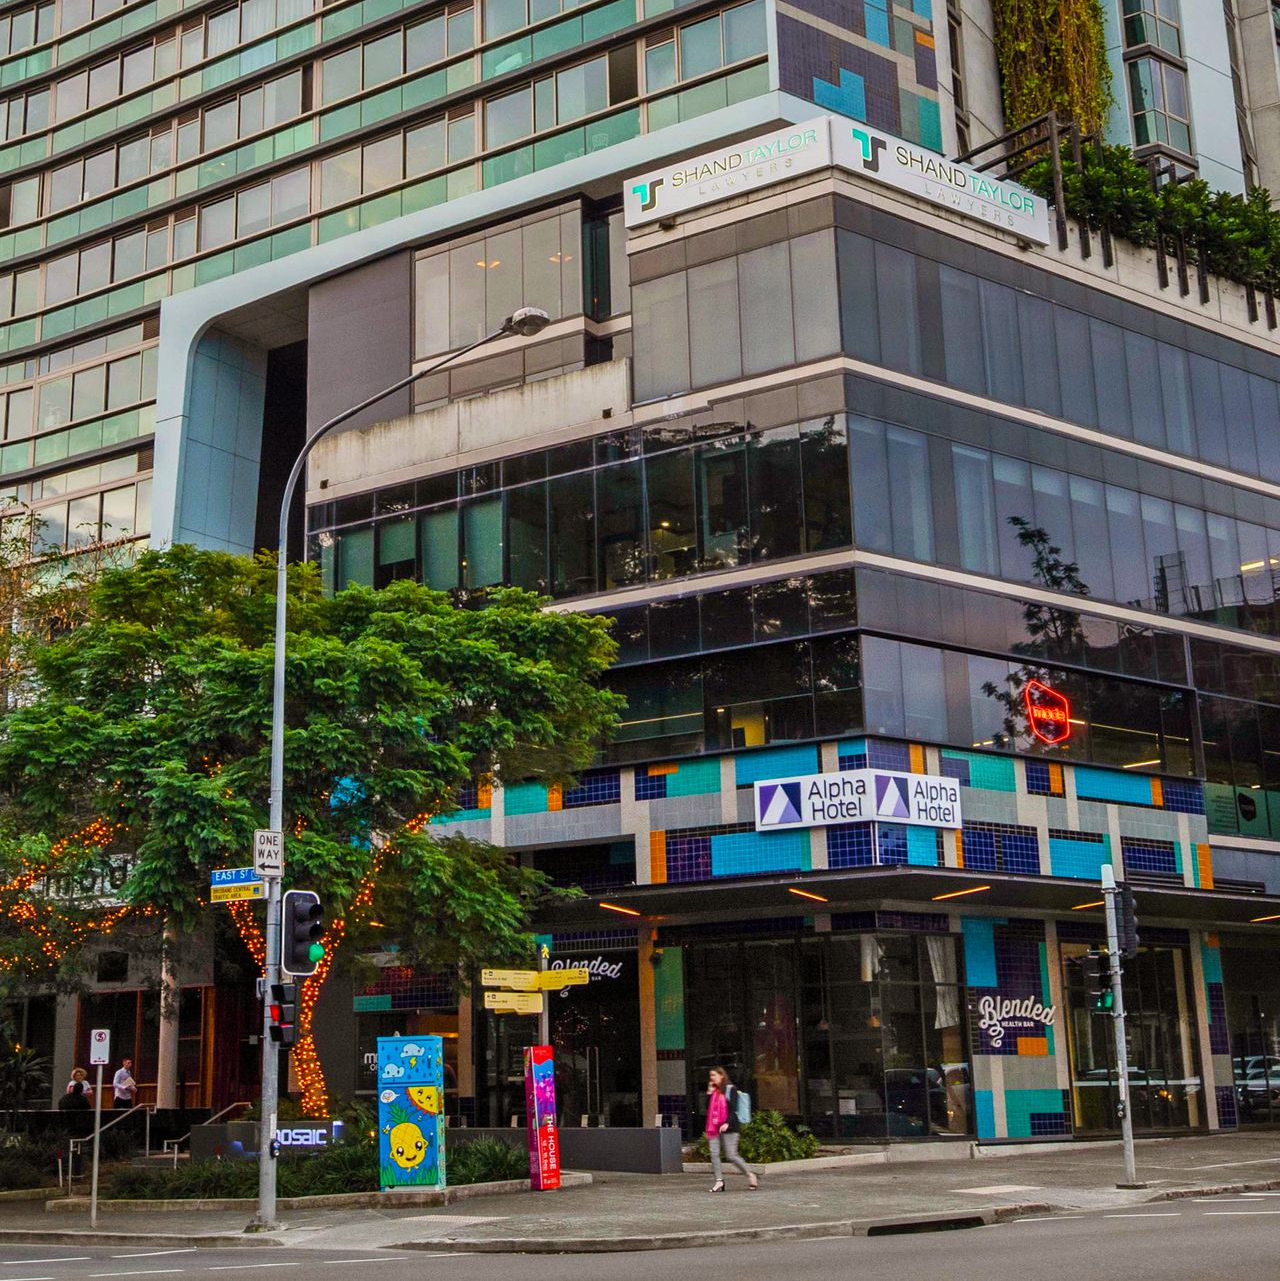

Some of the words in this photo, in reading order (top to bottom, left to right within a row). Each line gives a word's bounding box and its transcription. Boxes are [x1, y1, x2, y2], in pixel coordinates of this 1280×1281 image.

[671, 152, 743, 188] SHAND
[743, 128, 818, 165] TAYLOR
[697, 157, 795, 197] LAWYERS
[895, 145, 968, 189] SHAND
[968, 174, 1036, 218] TAYLOR
[923, 181, 1016, 227] LAWYERS
[1031, 705, 1067, 723] mode
[807, 777, 867, 802] Alpha
[913, 780, 958, 804] Alpha
[811, 796, 863, 821] Hotel
[916, 800, 956, 823] Hotel
[258, 834, 279, 847] ONE
[257, 849, 280, 860] WAY
[215, 870, 237, 881] EAST
[979, 995, 1057, 1048] Blended
[1001, 1020, 1022, 1028] HEALTH
[1023, 1020, 1035, 1028] BAR
[546, 1113, 555, 1133] THE
[548, 1135, 557, 1170] HOUSE
